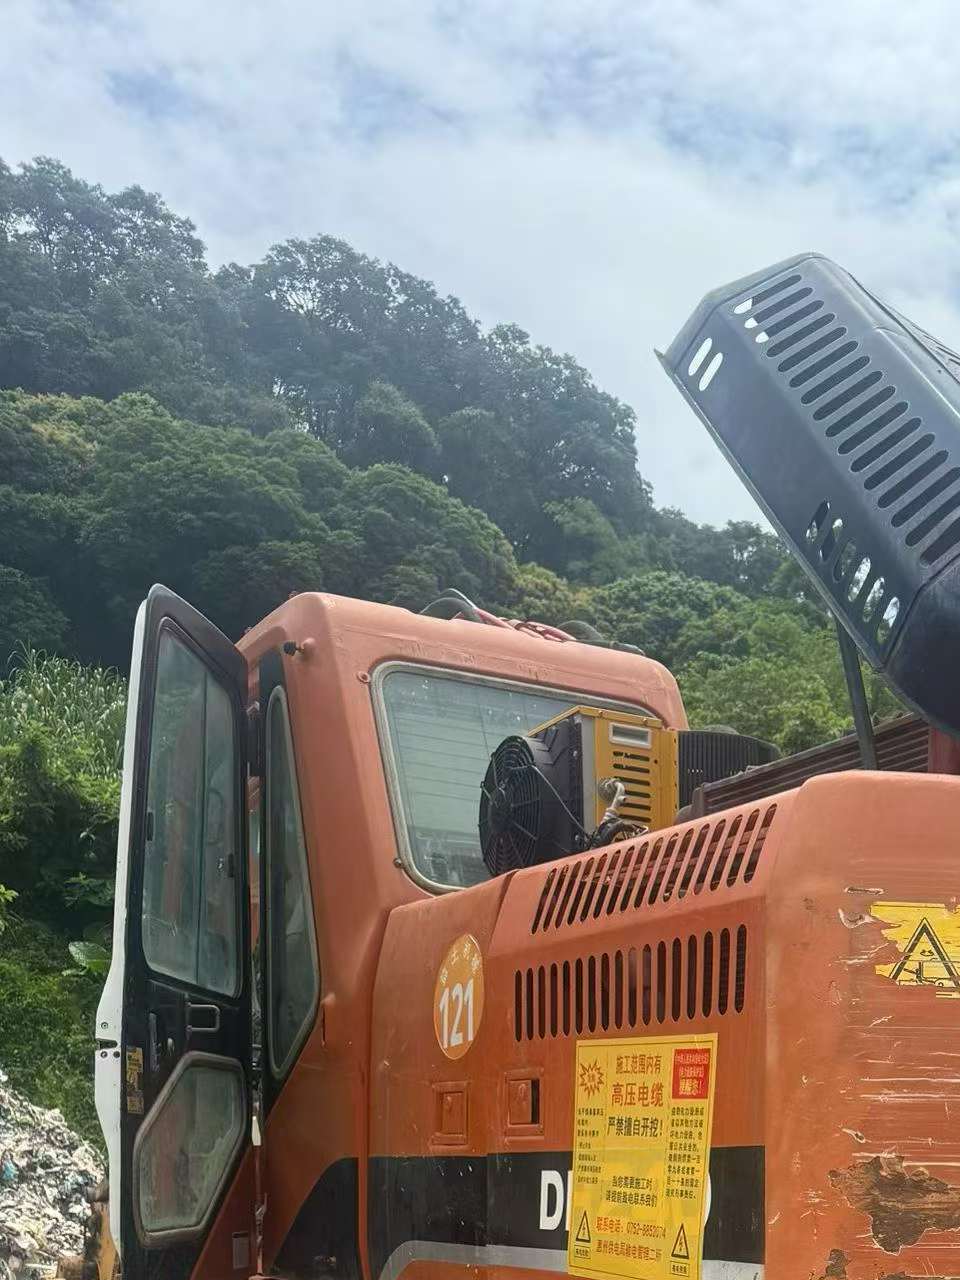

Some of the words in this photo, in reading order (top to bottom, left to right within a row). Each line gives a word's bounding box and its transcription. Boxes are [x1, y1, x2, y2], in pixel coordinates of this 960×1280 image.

[439, 977, 475, 1049] 121
[615, 1054, 662, 1075] 施工范围内有
[611, 1081, 664, 1108] 高压电缆
